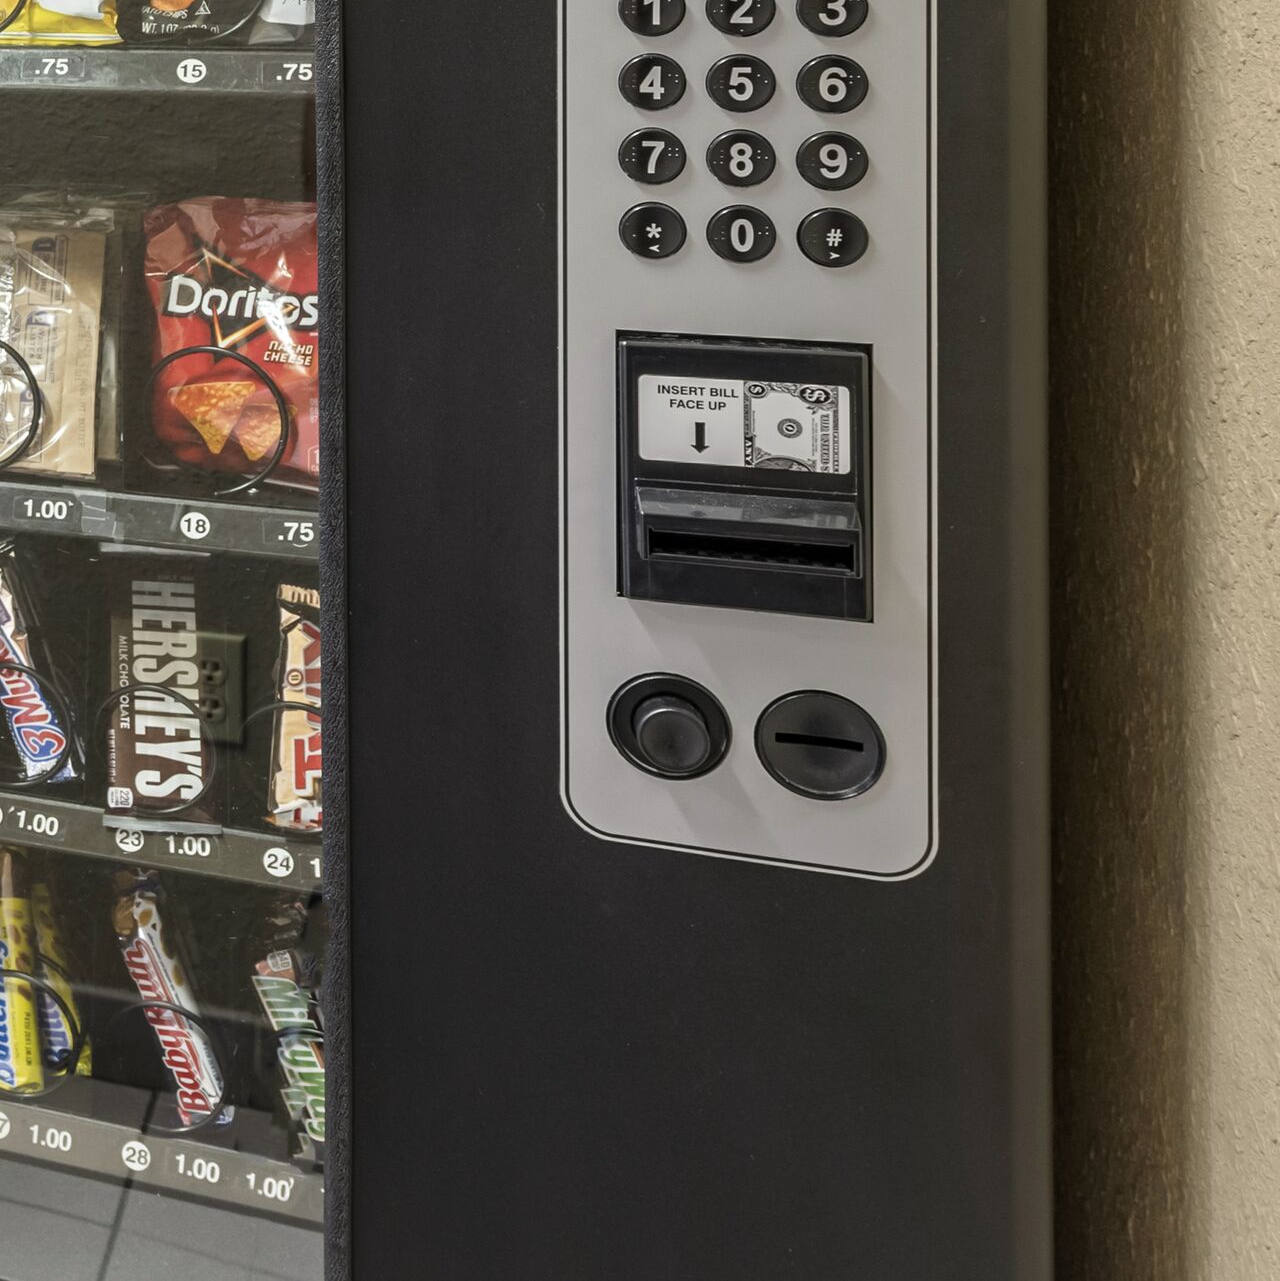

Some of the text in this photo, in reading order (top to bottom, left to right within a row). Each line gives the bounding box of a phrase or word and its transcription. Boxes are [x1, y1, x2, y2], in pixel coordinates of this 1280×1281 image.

[34, 58, 69, 76] .75
[275, 62, 313, 81] .75
[638, 65, 848, 103] 4 5 6
[641, 140, 848, 180] 7 8 9
[730, 217, 755, 253] 0
[166, 273, 318, 327] Doritos
[656, 383, 739, 400] INSERT BILL
[668, 397, 728, 412] FACE UP
[23, 498, 68, 520] 1.00
[277, 521, 315, 542] .75
[130, 580, 205, 802] HERSHEY'S
[21, 726, 66, 763] 3
[165, 835, 211, 858] 1.00
[162, 1027, 216, 1116] Baby
[28, 1123, 73, 1152] 1.00
[174, 1152, 221, 1184] 1.00
